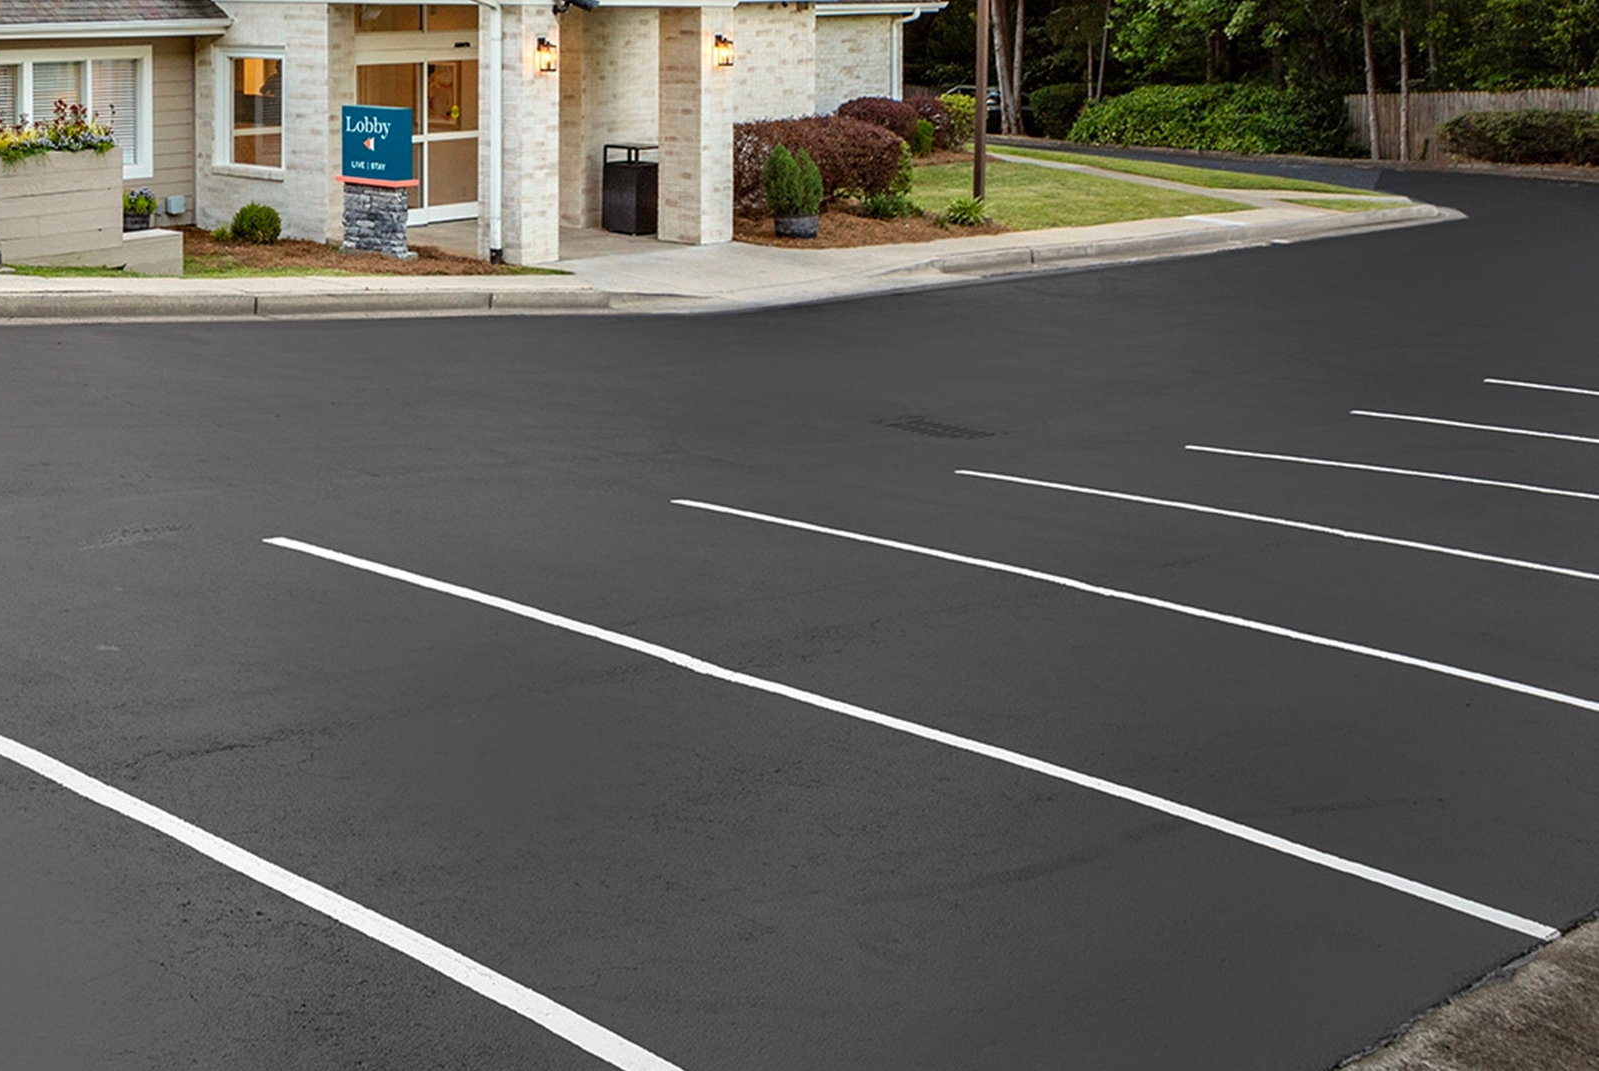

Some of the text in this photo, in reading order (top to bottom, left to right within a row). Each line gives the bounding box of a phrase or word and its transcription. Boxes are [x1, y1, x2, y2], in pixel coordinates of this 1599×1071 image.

[346, 116, 391, 139] Lobby
[351, 161, 386, 170] LIVE STAY
